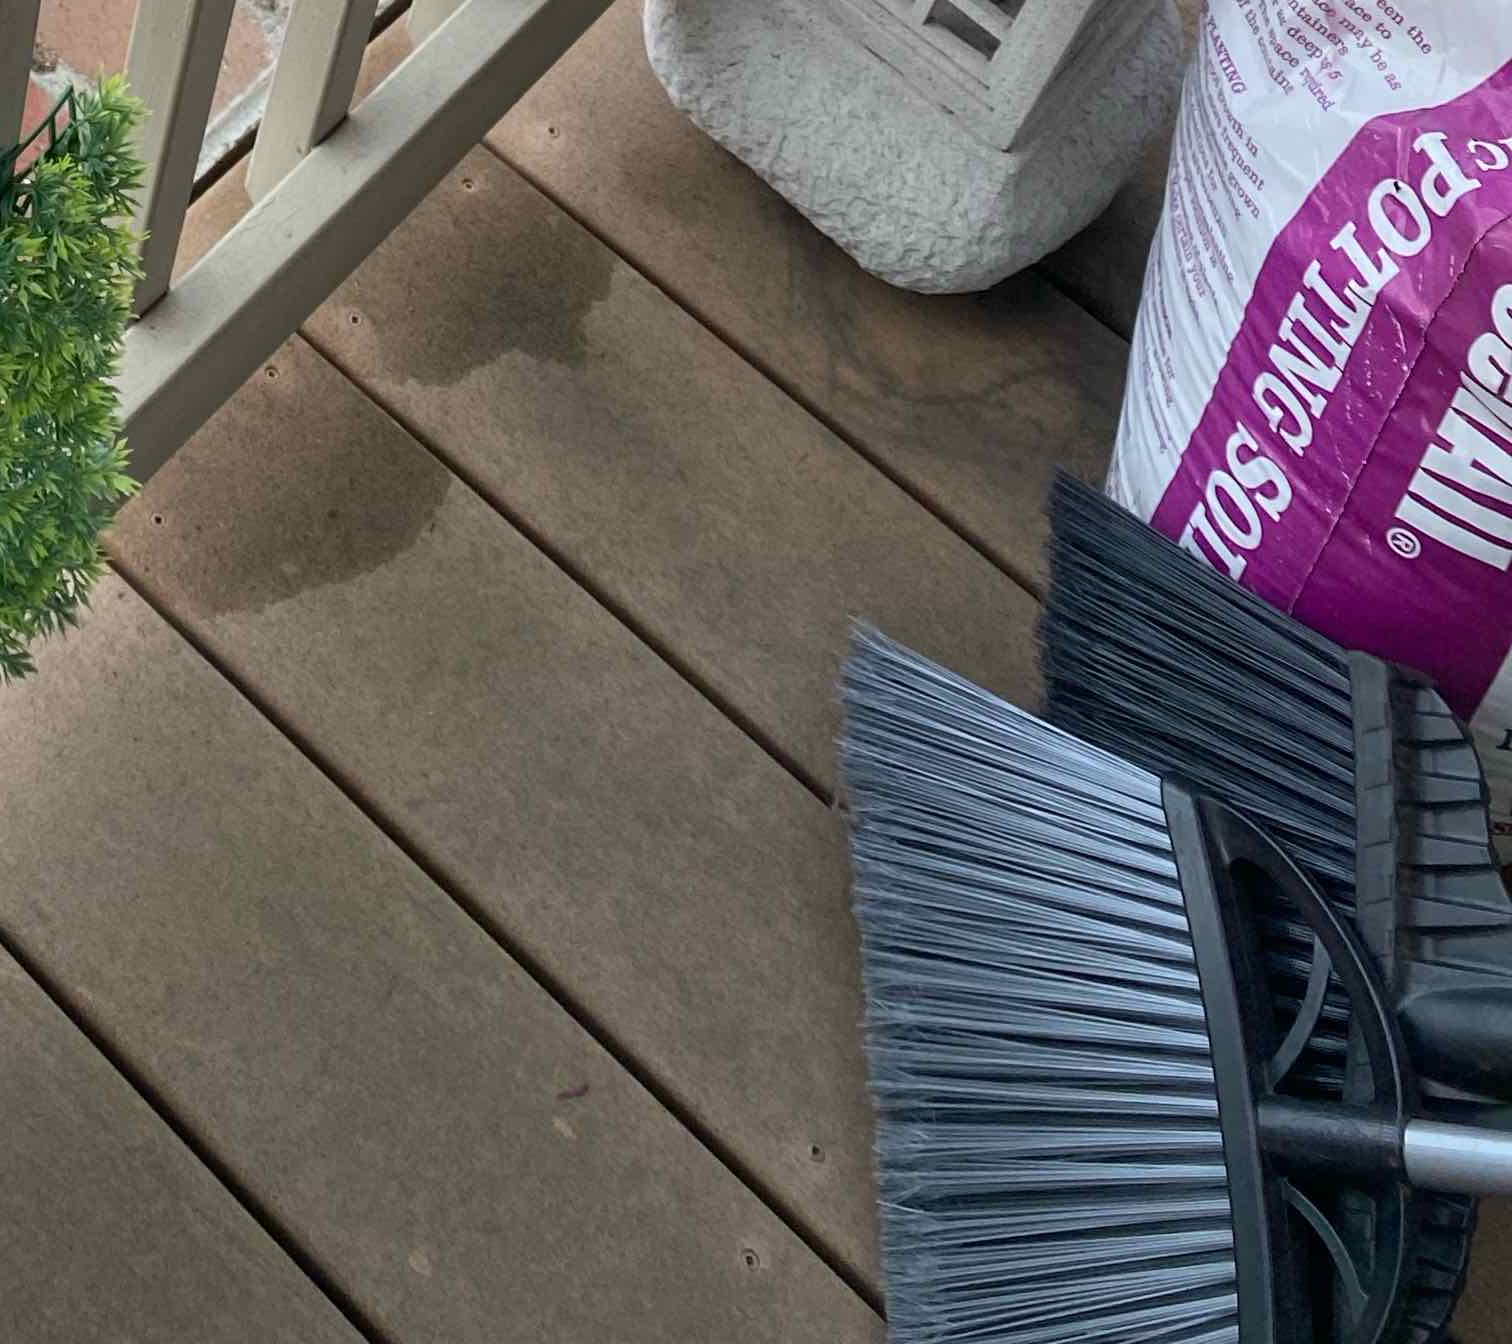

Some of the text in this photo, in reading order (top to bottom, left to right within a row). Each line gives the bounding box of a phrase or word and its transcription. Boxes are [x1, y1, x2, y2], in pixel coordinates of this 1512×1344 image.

[1287, 25, 1324, 59] deep
[1339, 16, 1373, 49] may
[1370, 48, 1388, 71] be
[1375, 22, 1392, 40] to
[1407, 25, 1433, 55] the
[1252, 131, 1482, 457] POTTING
